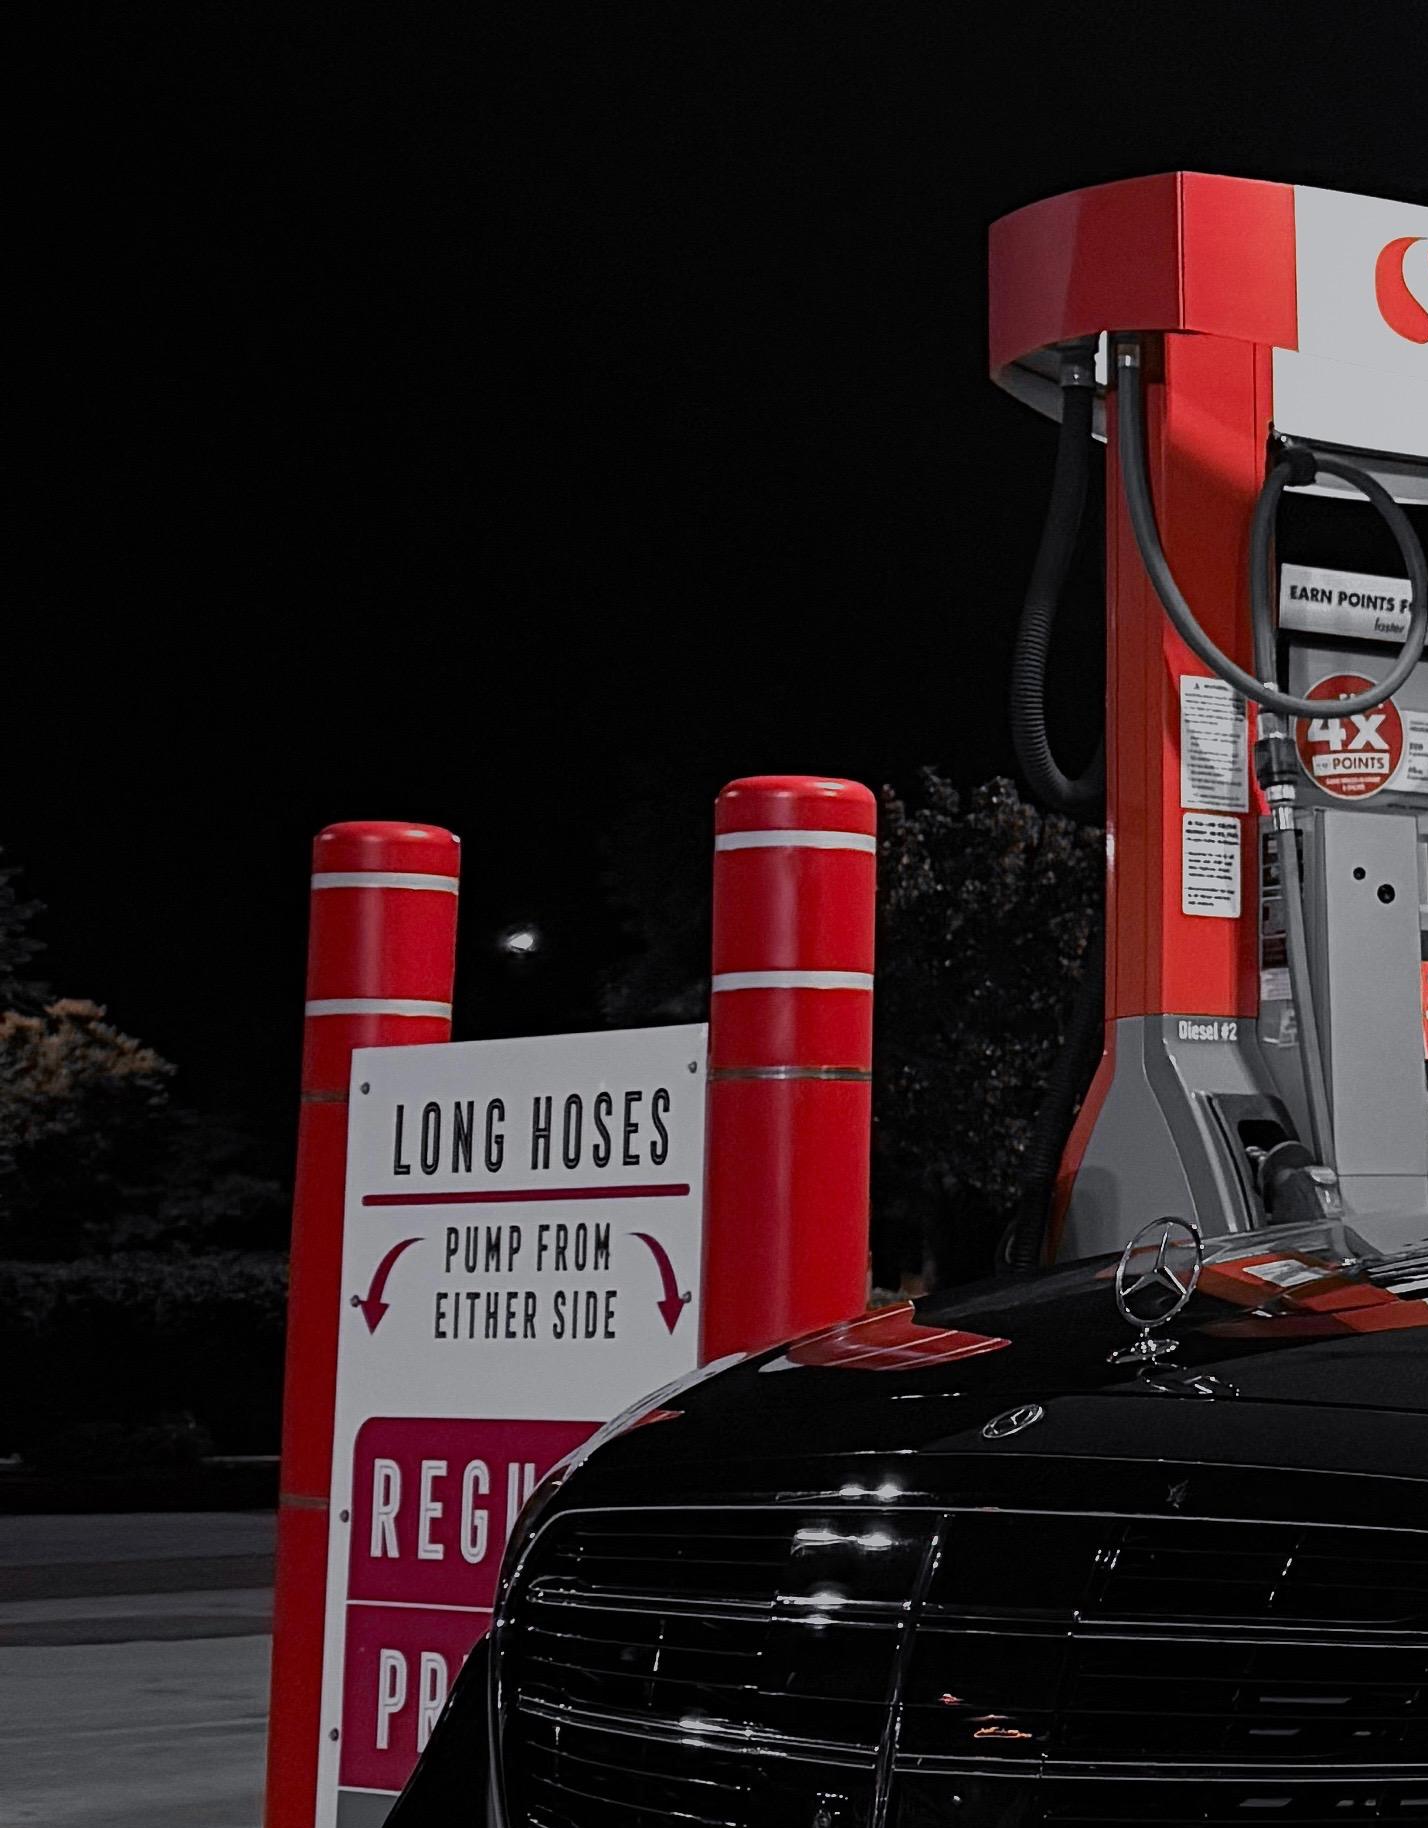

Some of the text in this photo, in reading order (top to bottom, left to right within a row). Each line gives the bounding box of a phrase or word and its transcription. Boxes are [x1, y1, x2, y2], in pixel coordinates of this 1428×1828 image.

[1289, 584, 1332, 605] EARN
[1338, 590, 1395, 613] POINTS
[1332, 756, 1385, 770] POINTS
[1178, 1020, 1219, 1041] Diesel
[393, 1087, 671, 1176] LONG HOSES
[445, 1222, 611, 1274] PUMP FROM
[434, 1289, 618, 1340] EITHER SIDE
[375, 1647, 468, 1754] PR
